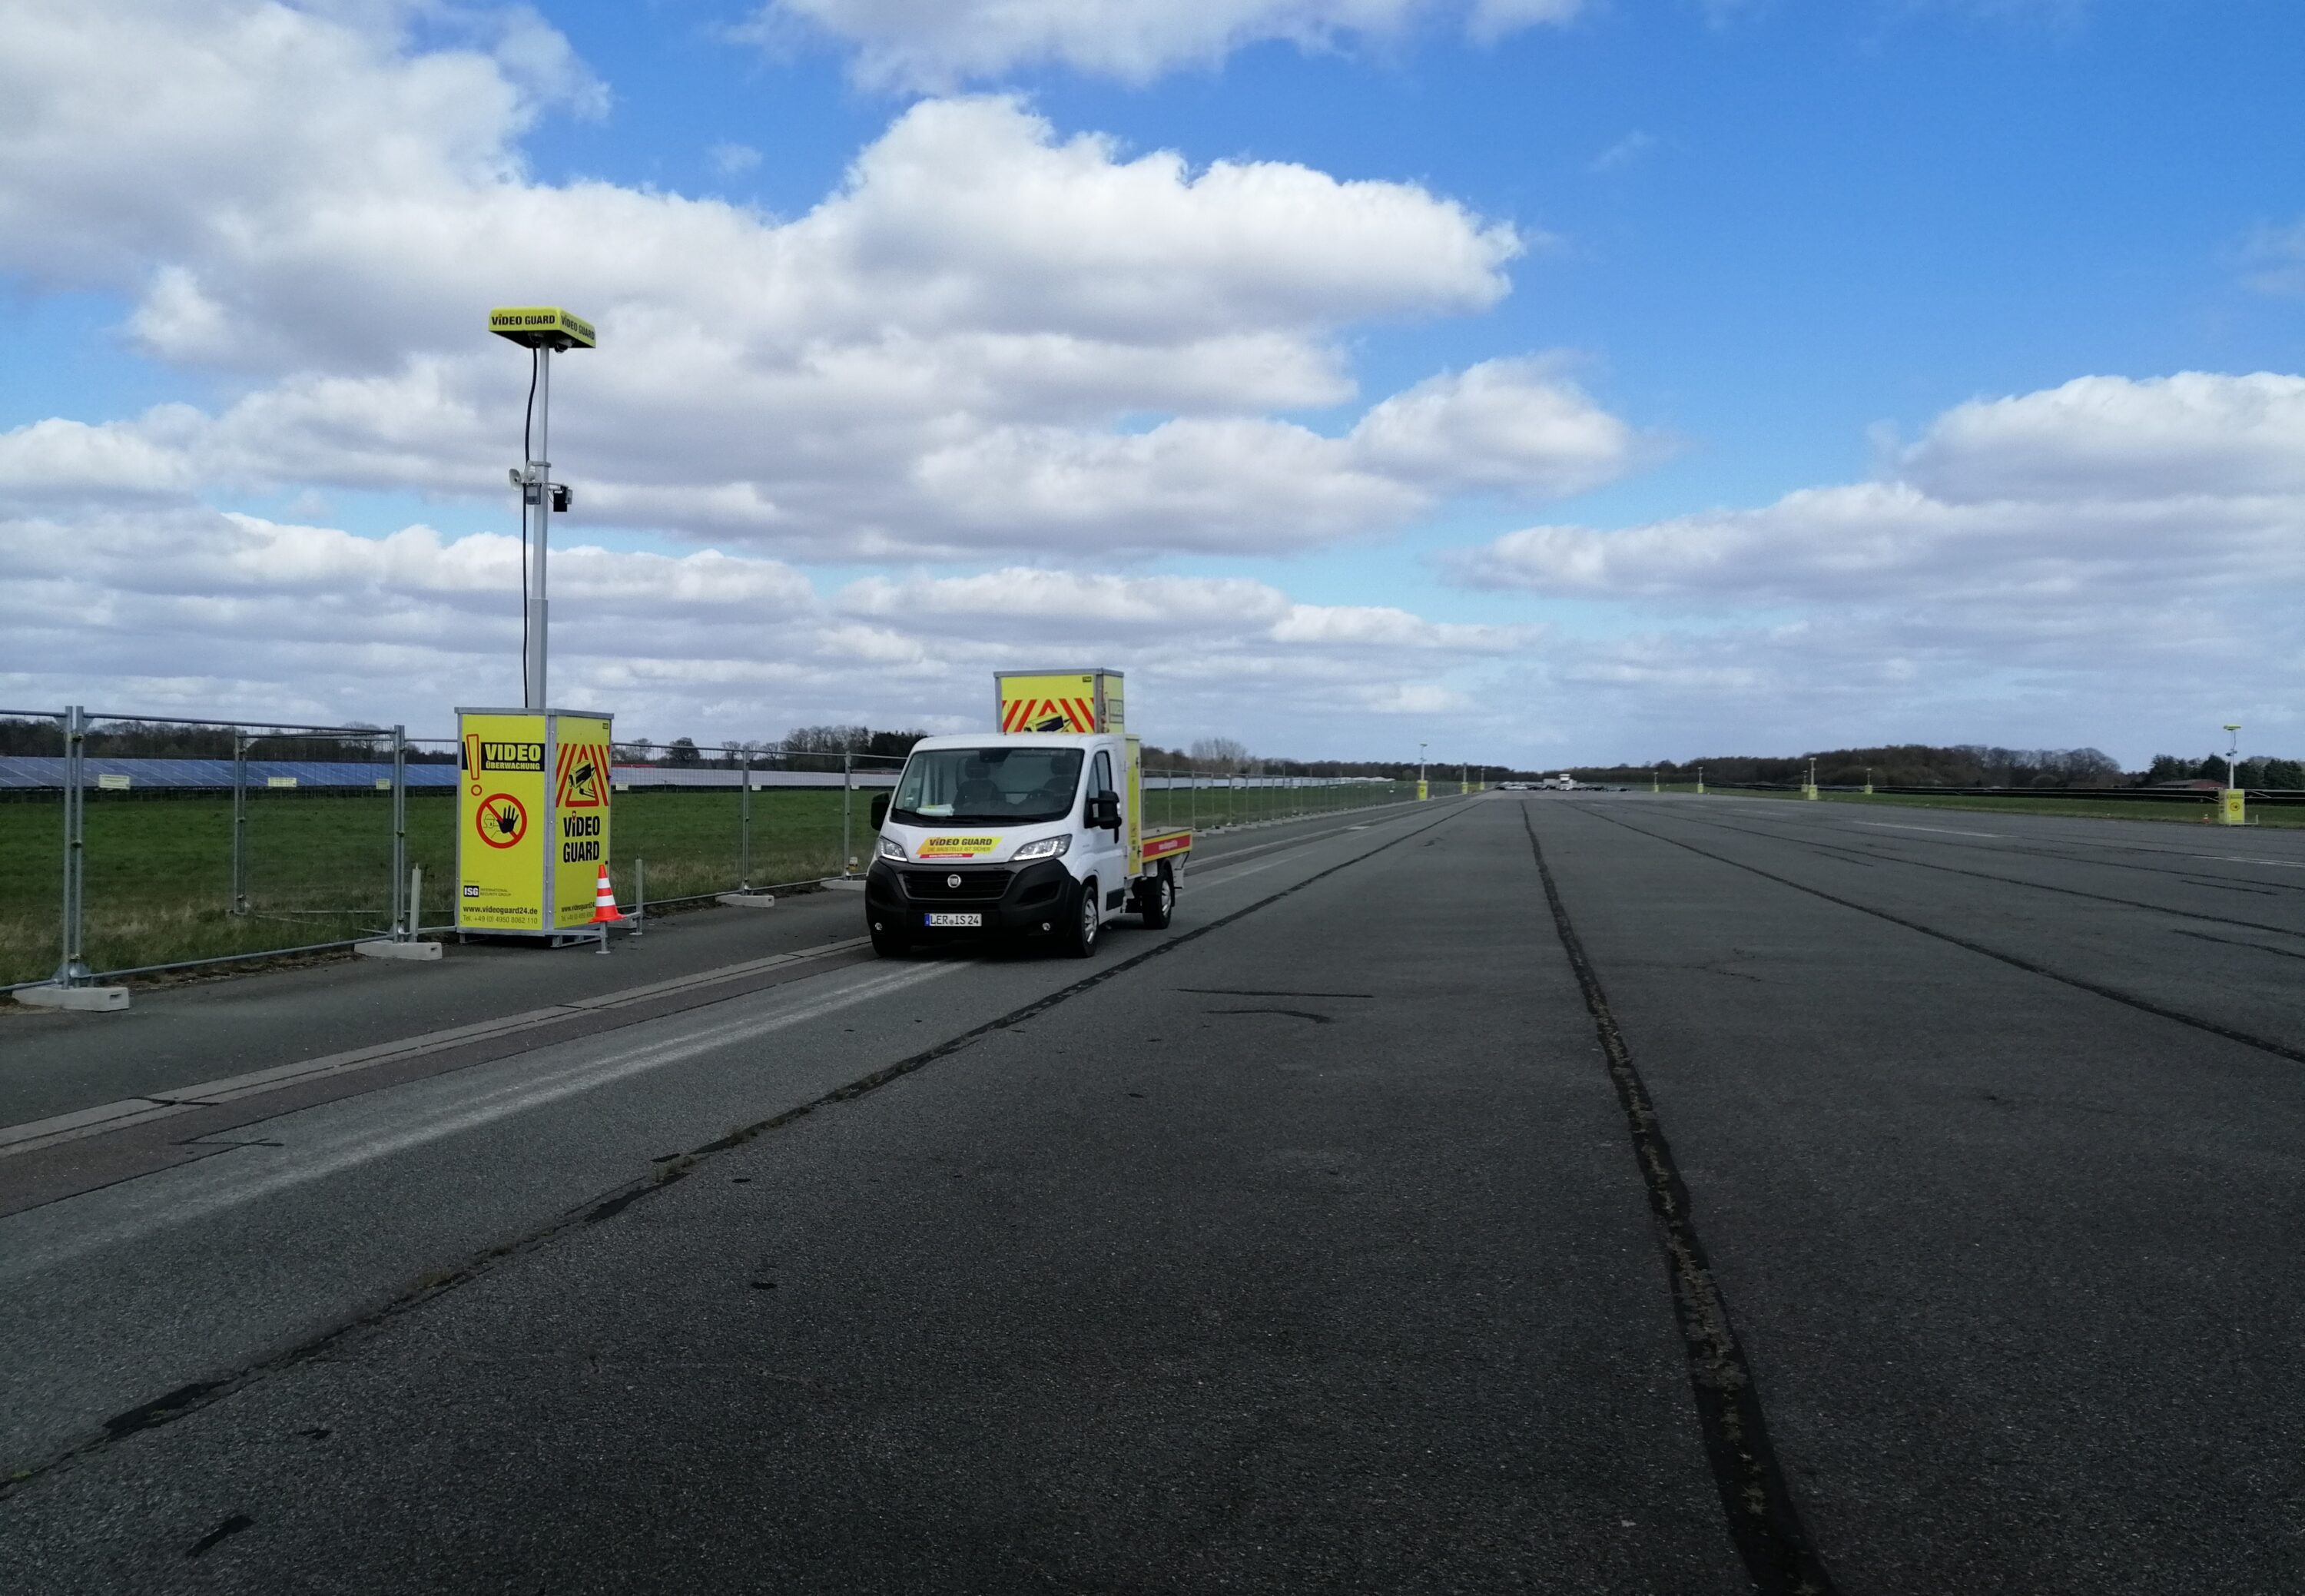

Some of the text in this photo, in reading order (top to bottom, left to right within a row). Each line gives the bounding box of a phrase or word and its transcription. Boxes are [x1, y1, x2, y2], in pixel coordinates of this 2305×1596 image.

[525, 315, 555, 324] GUARD
[579, 324, 595, 340] GUARD
[485, 744, 541, 762] VIDEO
[486, 761, 540, 770] ÜBERWACHUNG
[563, 841, 599, 863] GUARD
[464, 887, 479, 896] ISG
[463, 906, 538, 914] www.videoguard24.de
[930, 915, 948, 924] LER
[967, 915, 979, 924] 24
